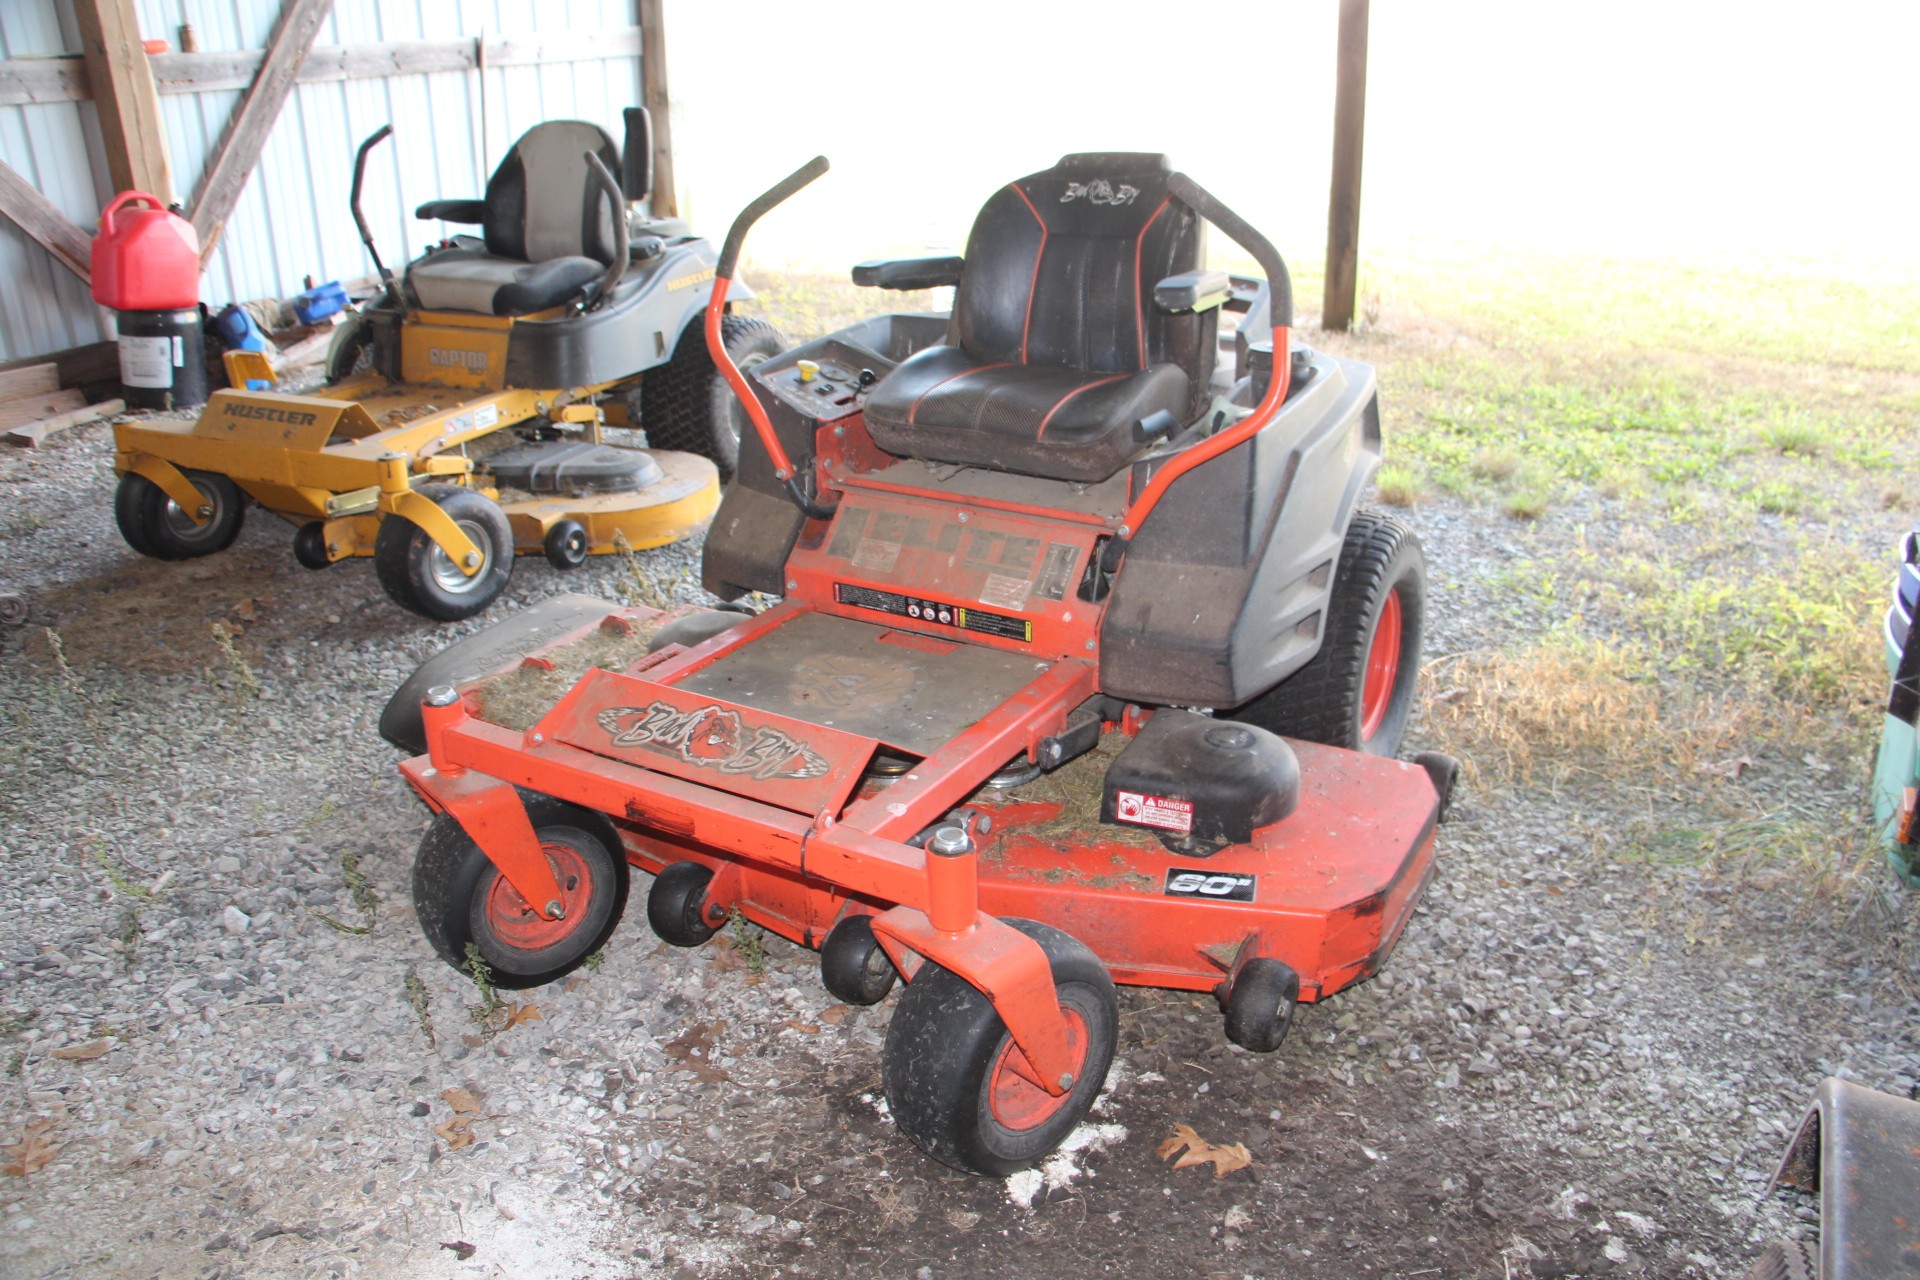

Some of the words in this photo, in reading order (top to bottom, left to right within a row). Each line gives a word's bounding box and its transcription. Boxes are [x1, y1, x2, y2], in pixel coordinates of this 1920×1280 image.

[429, 347, 488, 369] RAPTOR
[223, 402, 317, 427] HUSTLER
[613, 702, 696, 748] Bad
[723, 728, 809, 780] Boy
[1157, 799, 1190, 812] DANGER
